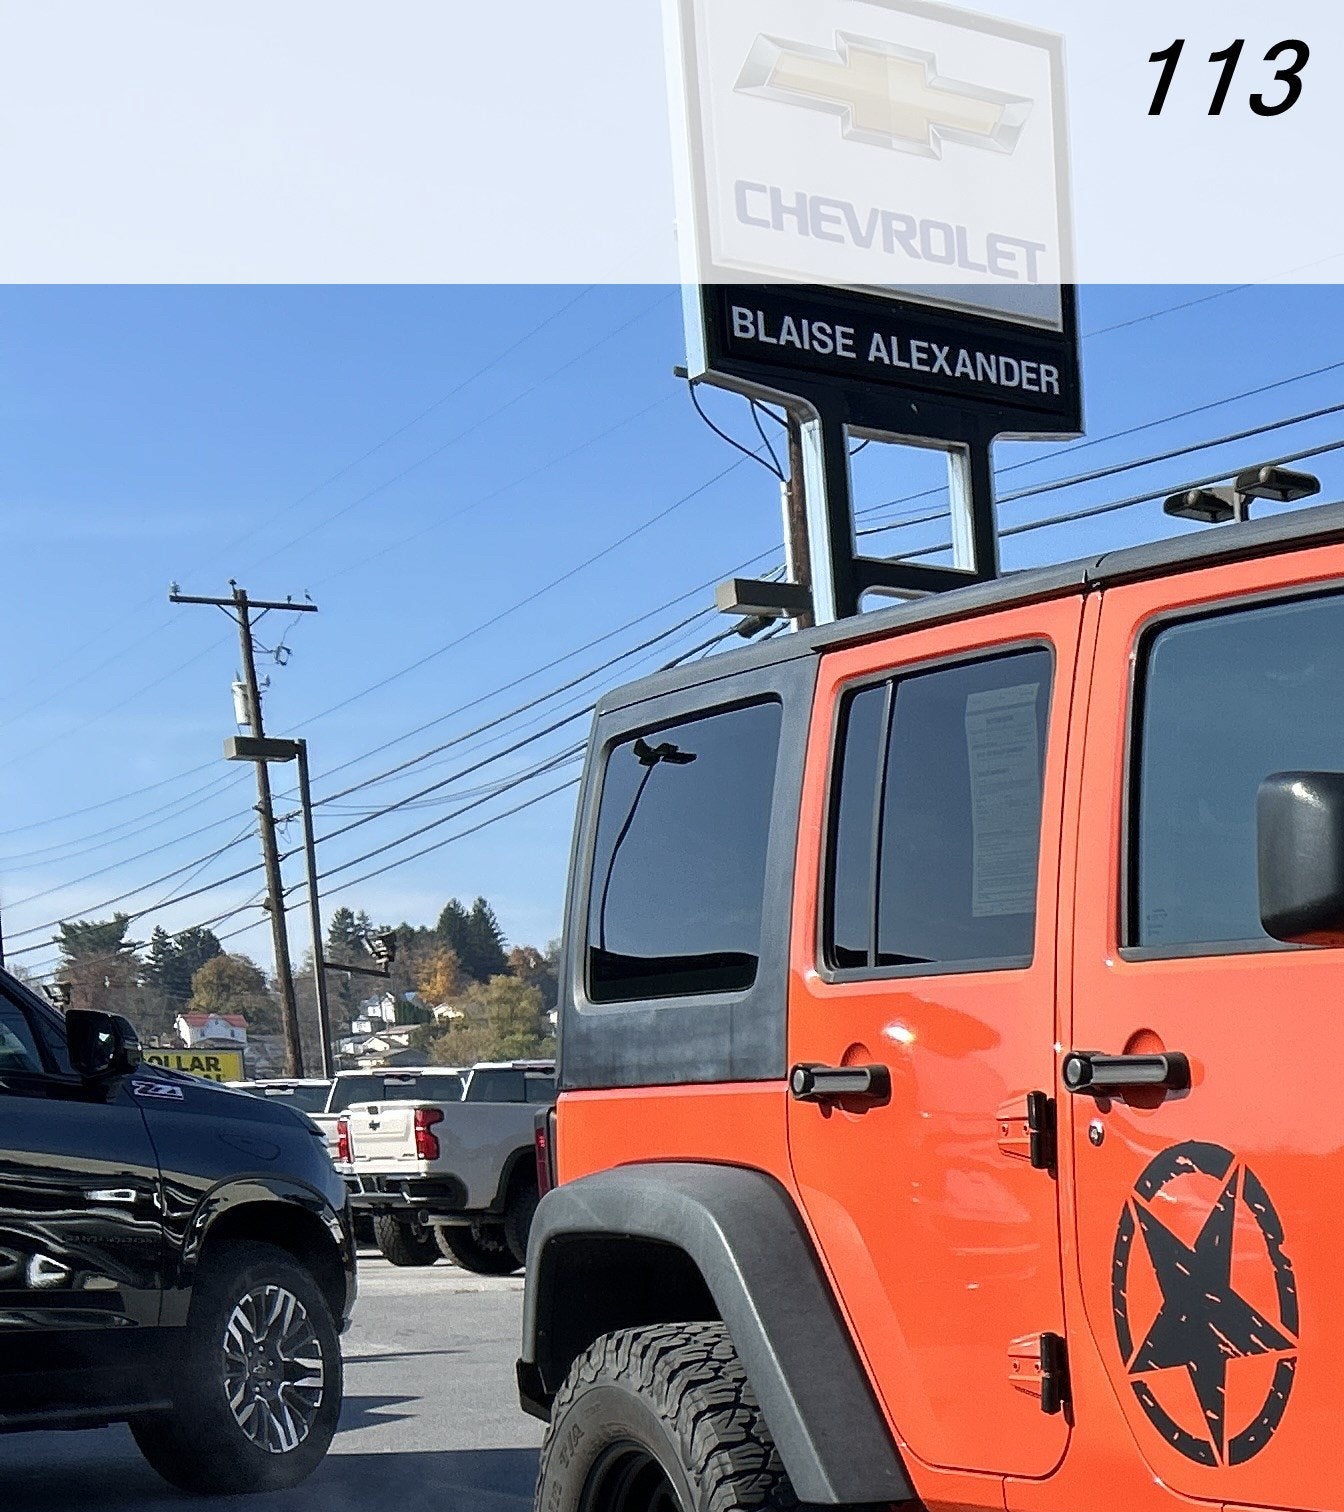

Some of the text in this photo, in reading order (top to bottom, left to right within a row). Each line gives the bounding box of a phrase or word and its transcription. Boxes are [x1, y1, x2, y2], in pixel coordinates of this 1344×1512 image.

[733, 178, 1046, 284] CHEVROLET
[731, 305, 1060, 396] BLAISE ALEXANDER
[147, 1055, 222, 1072] OLLAR
